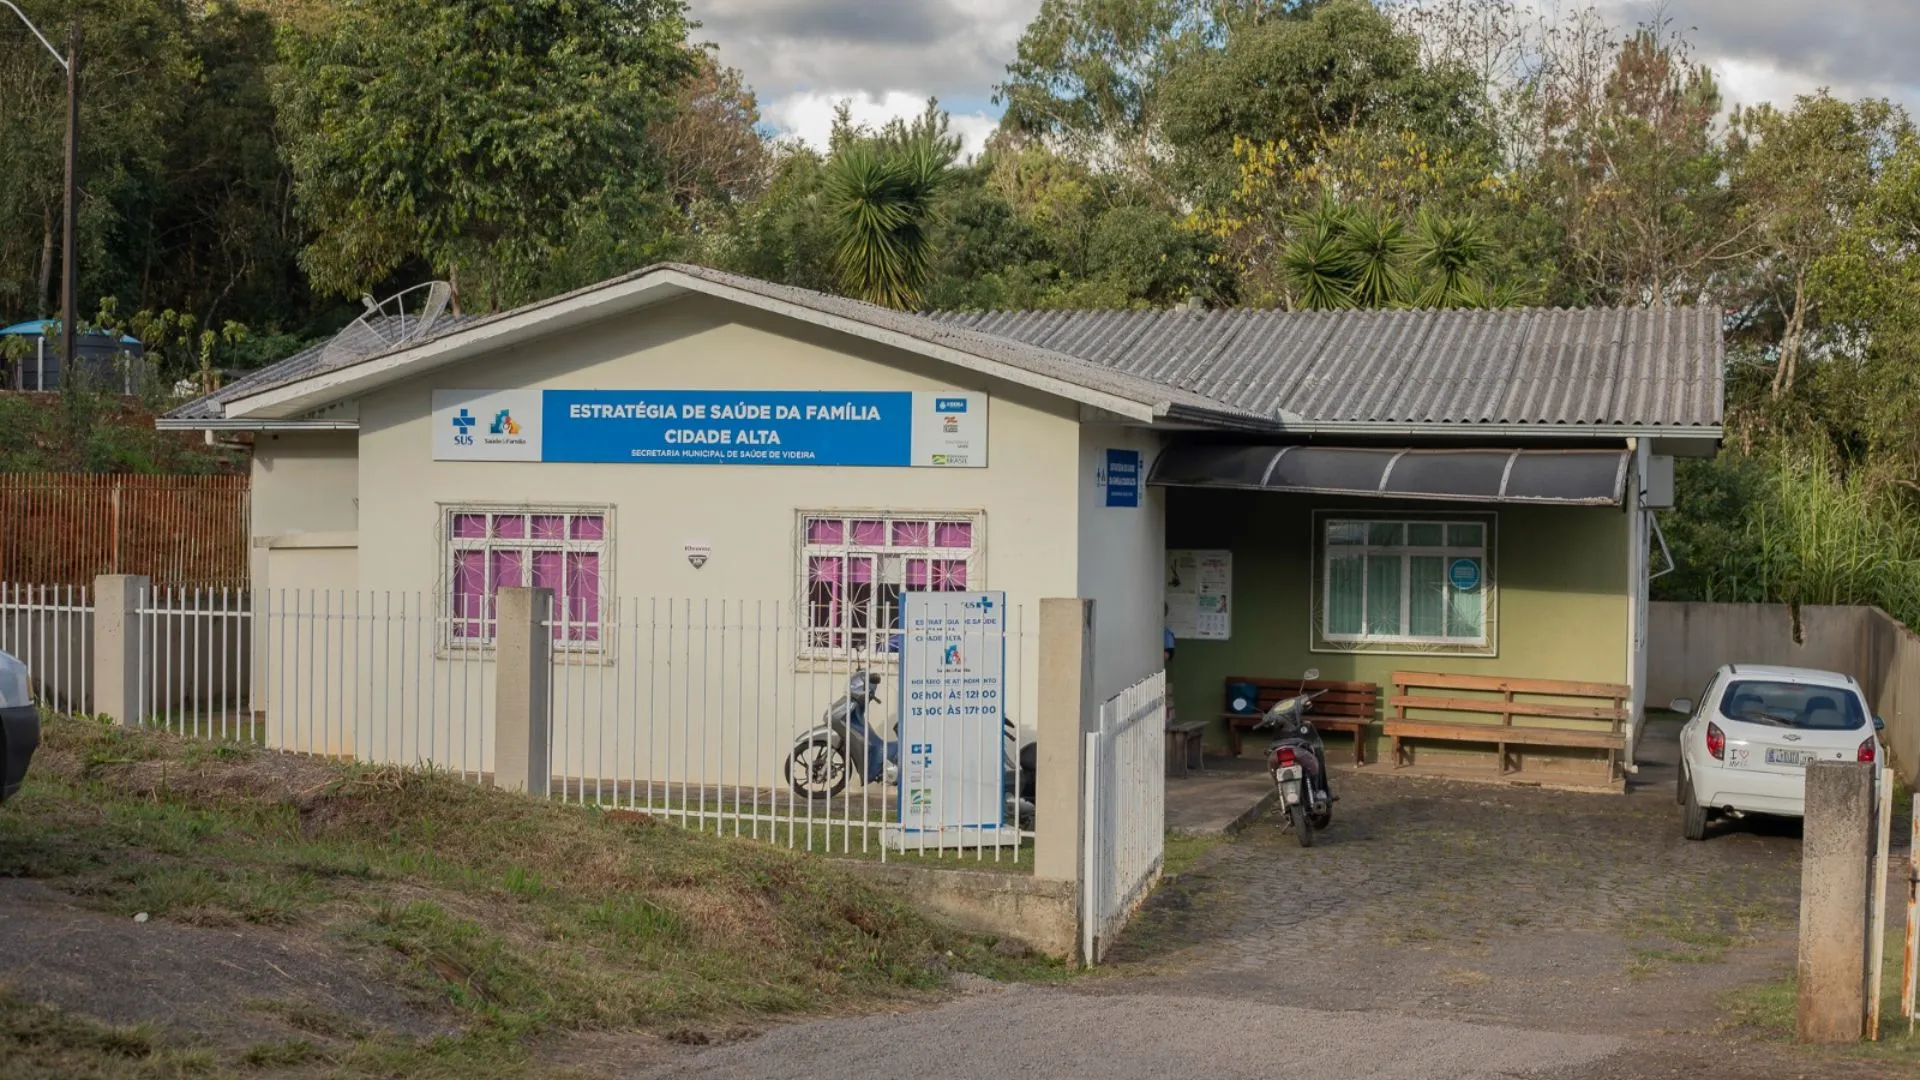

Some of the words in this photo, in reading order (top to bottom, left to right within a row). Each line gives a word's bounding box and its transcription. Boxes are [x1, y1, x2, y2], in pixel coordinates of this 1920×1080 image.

[570, 401, 677, 418] ESTRATÉGIA
[682, 404, 706, 419] DE
[710, 401, 771, 419] SAÚDE
[776, 405, 801, 420] DA
[806, 402, 881, 421] FAMÍLIA
[454, 435, 474, 445] SUS
[664, 429, 731, 444] CIDADE
[736, 430, 781, 445] ALTA
[631, 449, 680, 457] SECRETARIA
[682, 449, 725, 458] MUNICIPAL
[727, 450, 738, 458] DE
[740, 449, 767, 458] SAÚDE
[769, 450, 780, 458] DE
[782, 451, 816, 459] VIDEIRA
